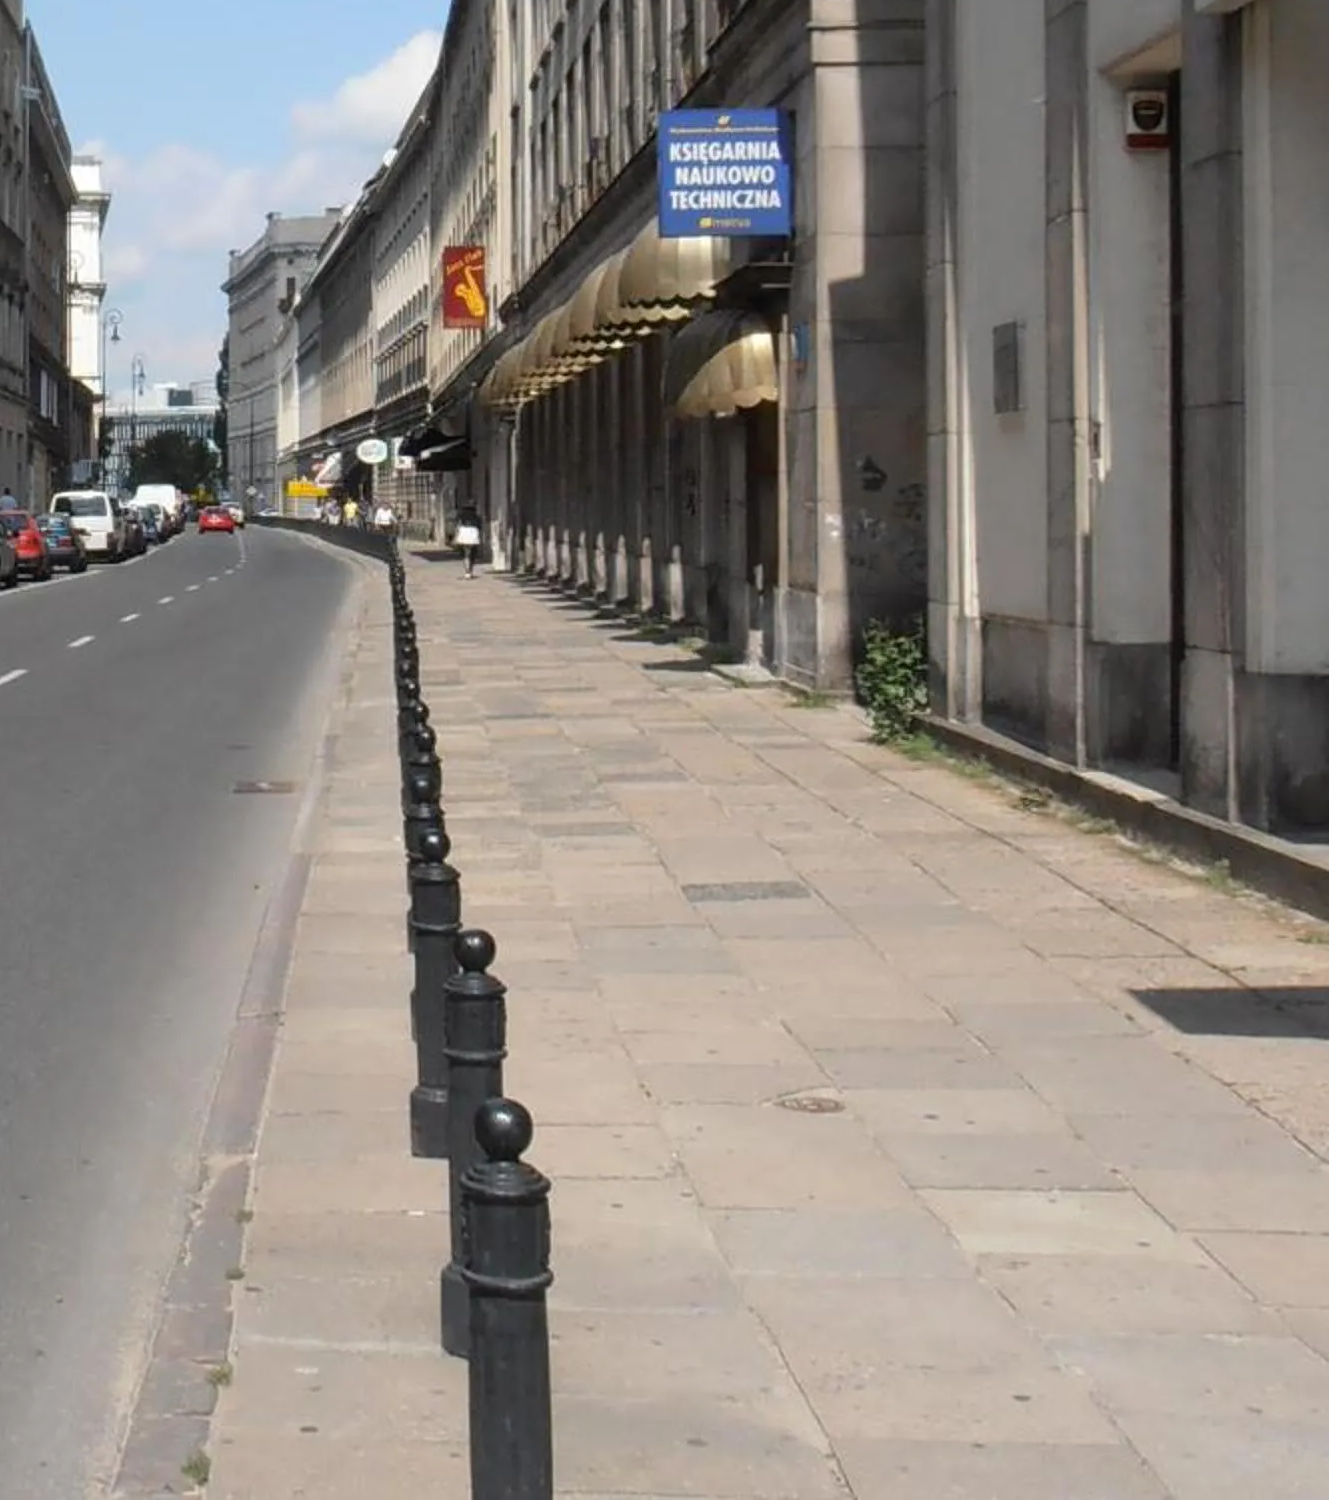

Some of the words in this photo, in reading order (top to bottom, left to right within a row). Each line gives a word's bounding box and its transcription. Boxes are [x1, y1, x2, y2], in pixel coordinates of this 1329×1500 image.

[669, 141, 781, 164] KSIĘGARNIA
[674, 165, 776, 186] NAUKOWO
[669, 189, 781, 210] TECHNICZNA
